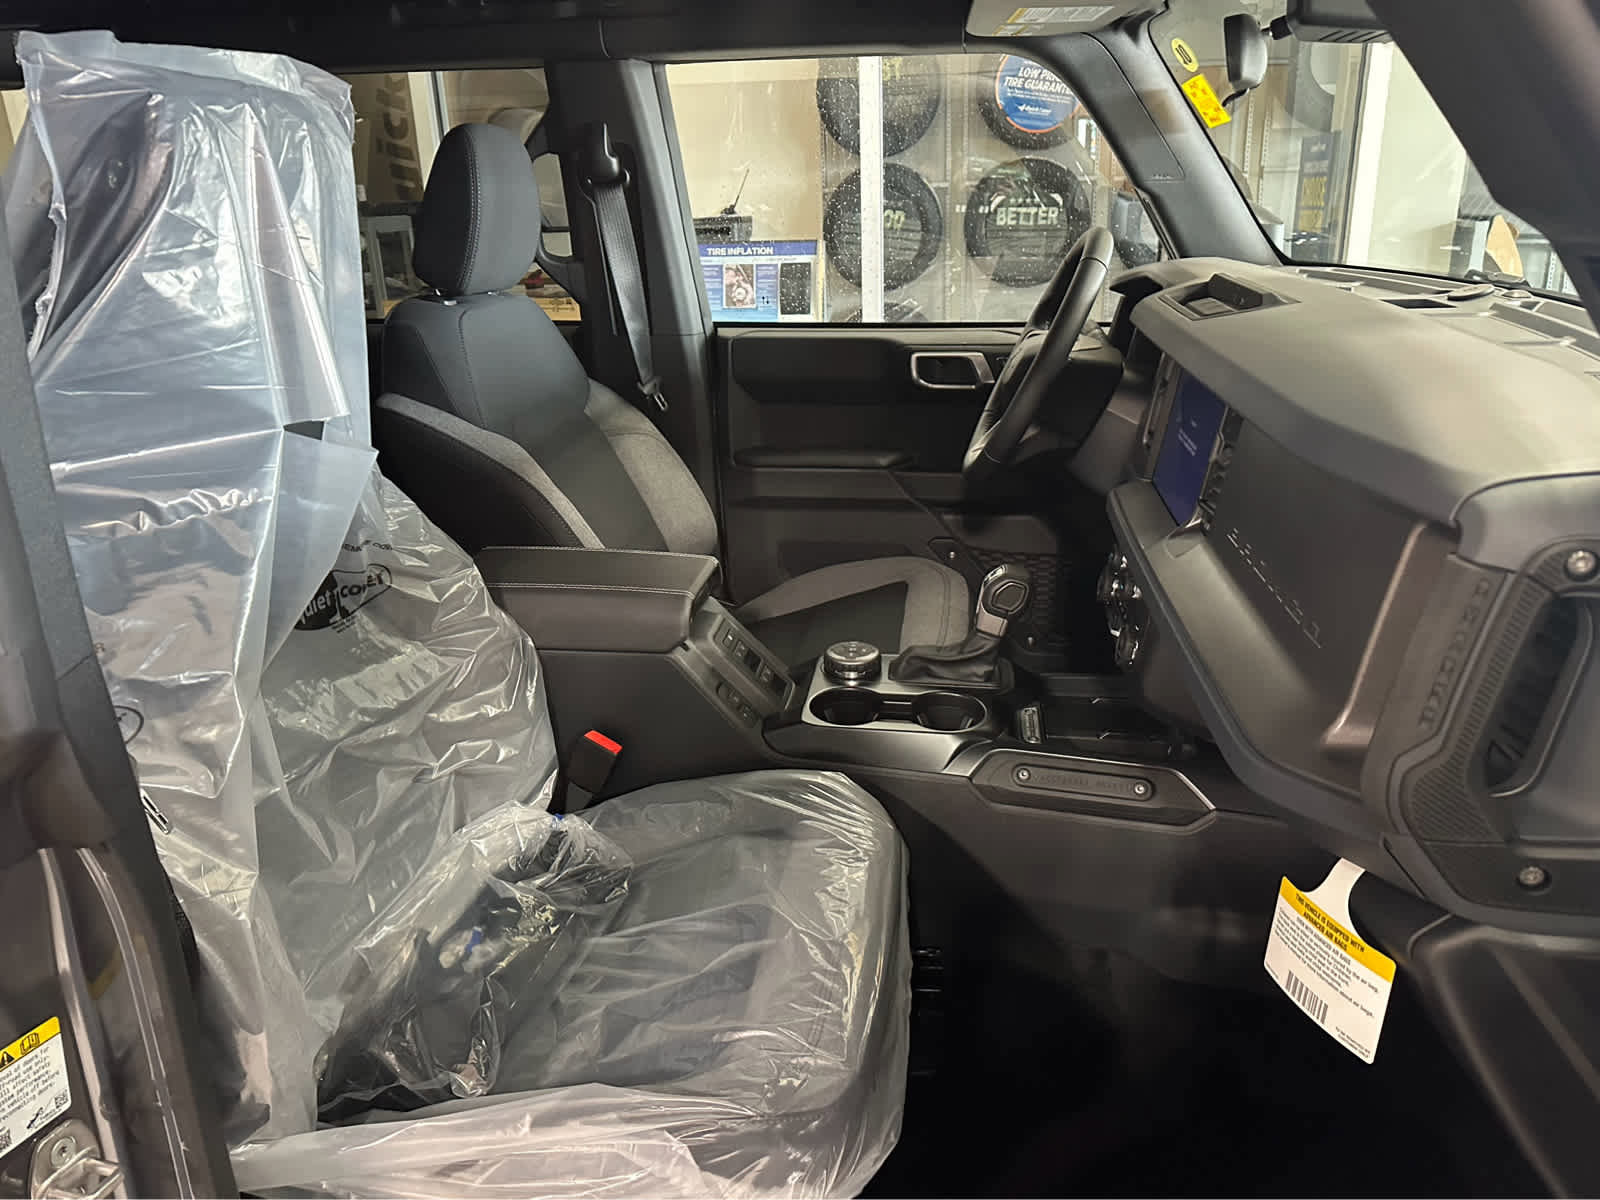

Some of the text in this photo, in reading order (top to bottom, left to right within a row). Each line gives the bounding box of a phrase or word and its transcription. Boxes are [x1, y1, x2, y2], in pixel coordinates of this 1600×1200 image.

[1018, 67, 1041, 78] LOW
[1004, 76, 1025, 87] TIRE
[996, 207, 1059, 226] BETTER
[706, 246, 775, 256] TIRE INFLATION
